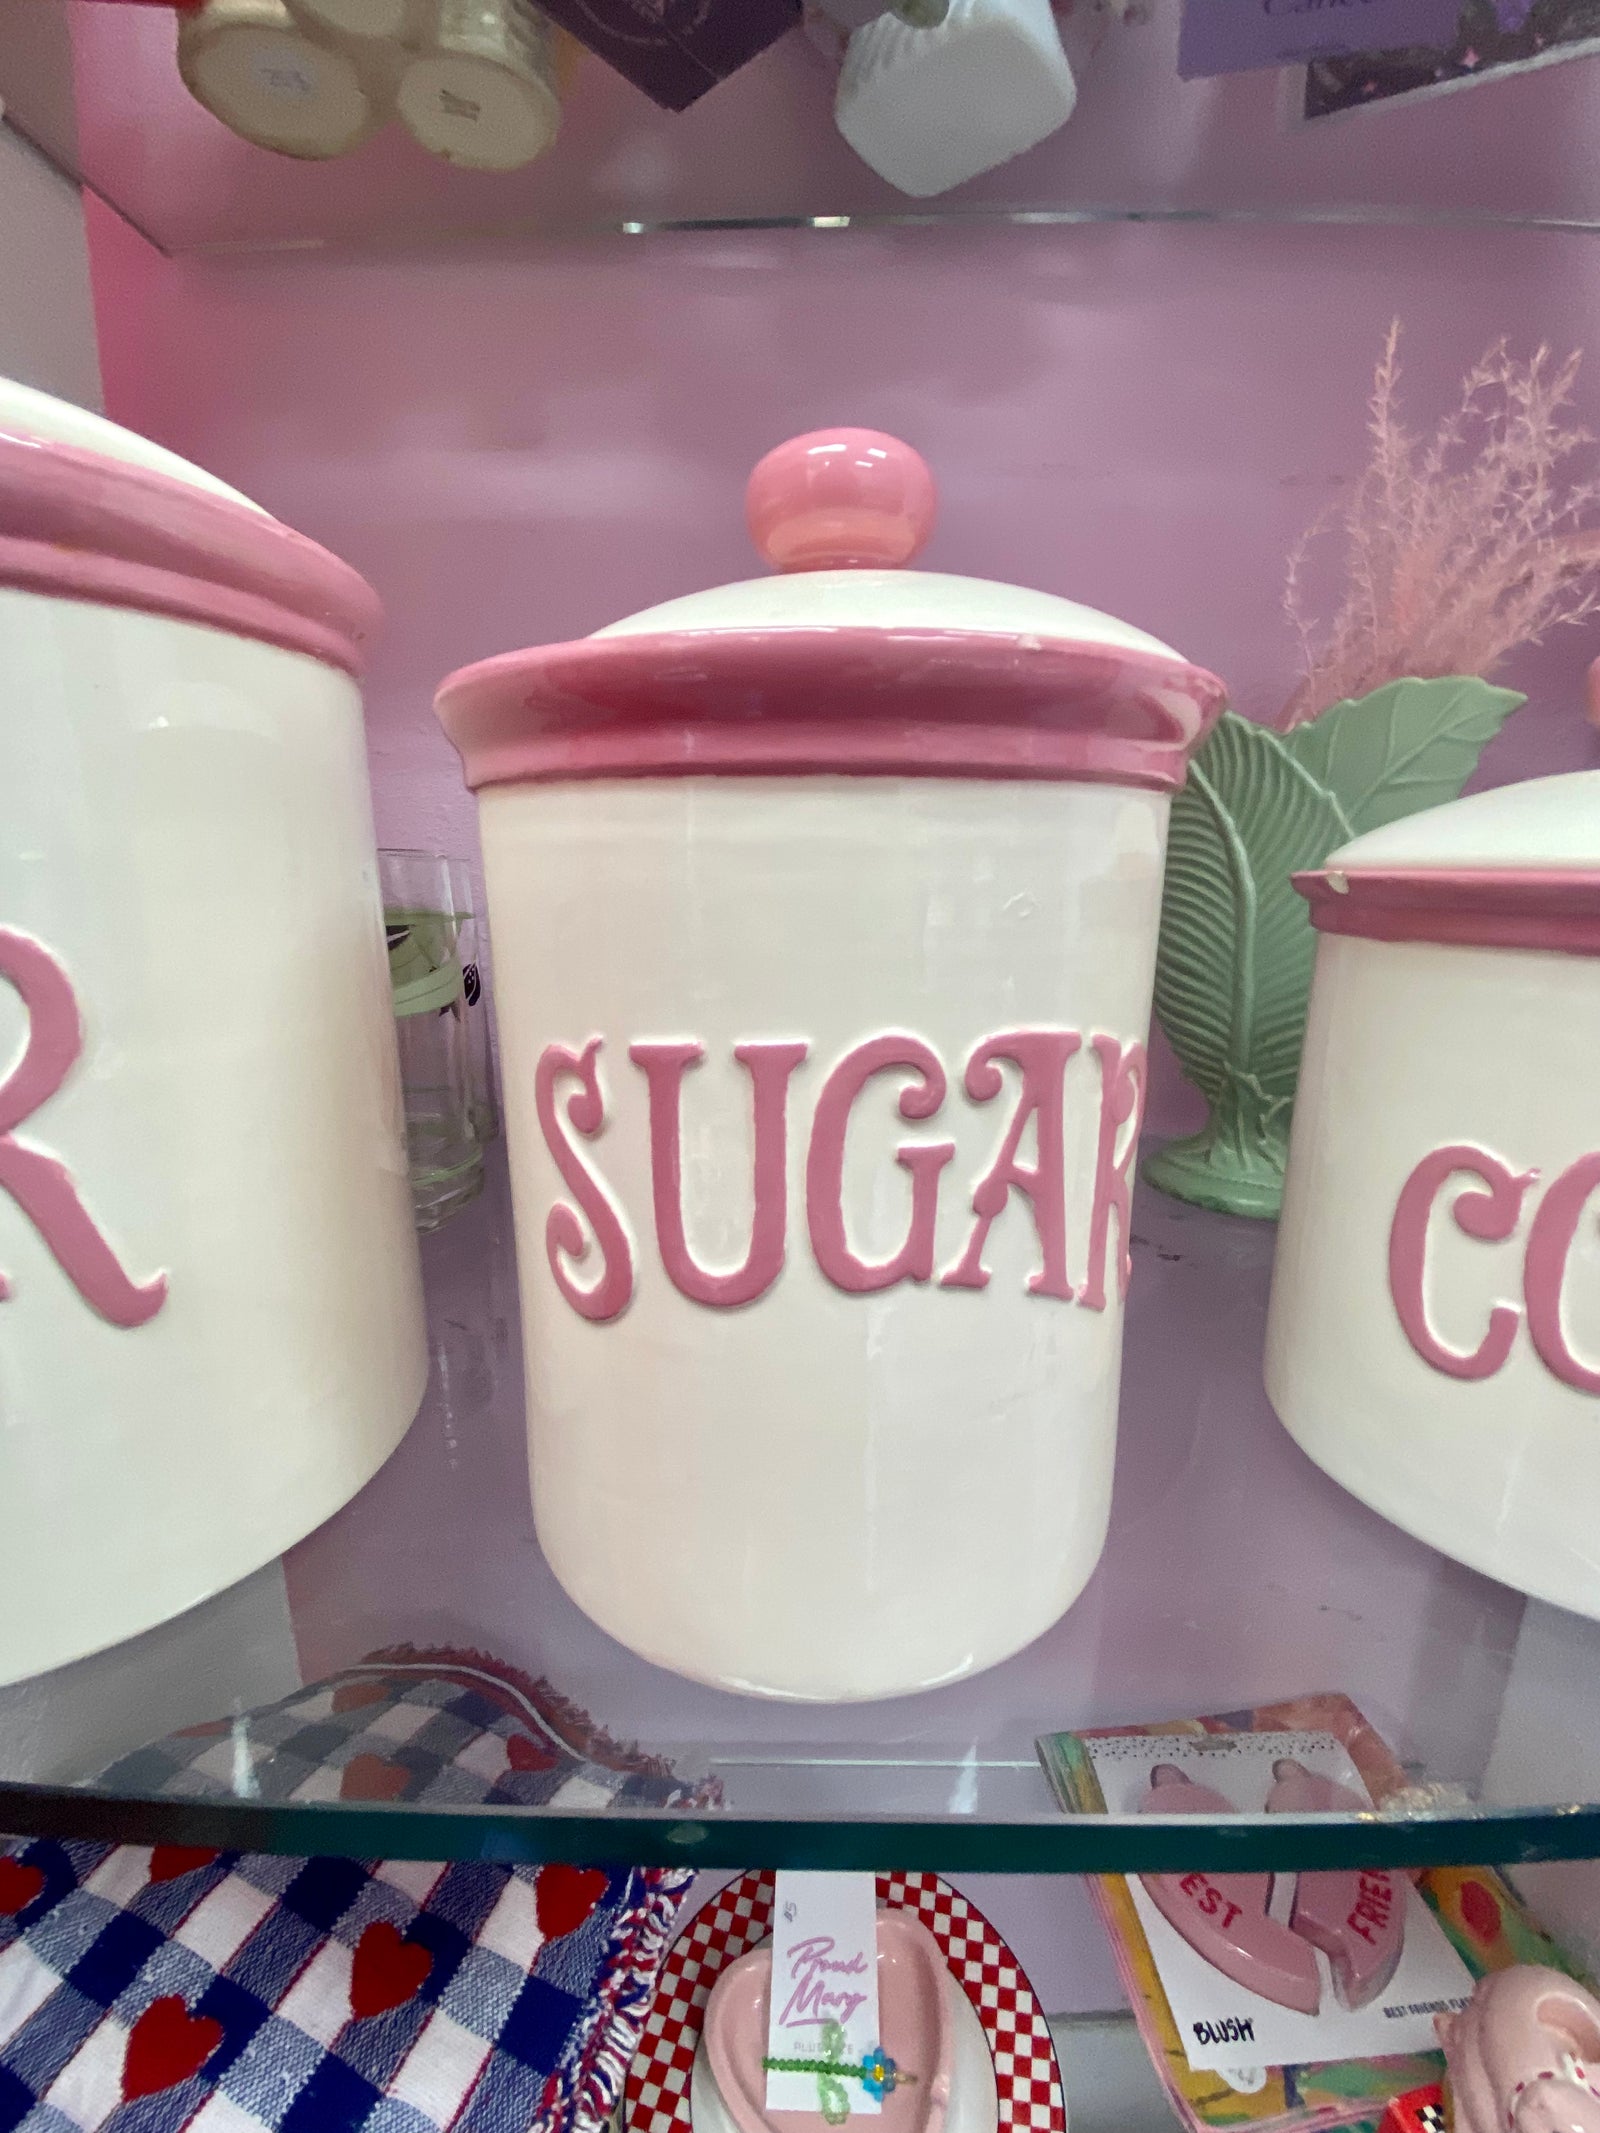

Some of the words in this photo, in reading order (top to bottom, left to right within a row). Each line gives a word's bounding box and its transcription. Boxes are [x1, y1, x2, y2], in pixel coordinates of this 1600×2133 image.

[533, 1027, 1149, 1322] SUGAR
[787, 1936, 868, 1979] Proud
[778, 1960, 868, 2028] Mary
[1193, 2016, 1255, 2045] BLUSH
